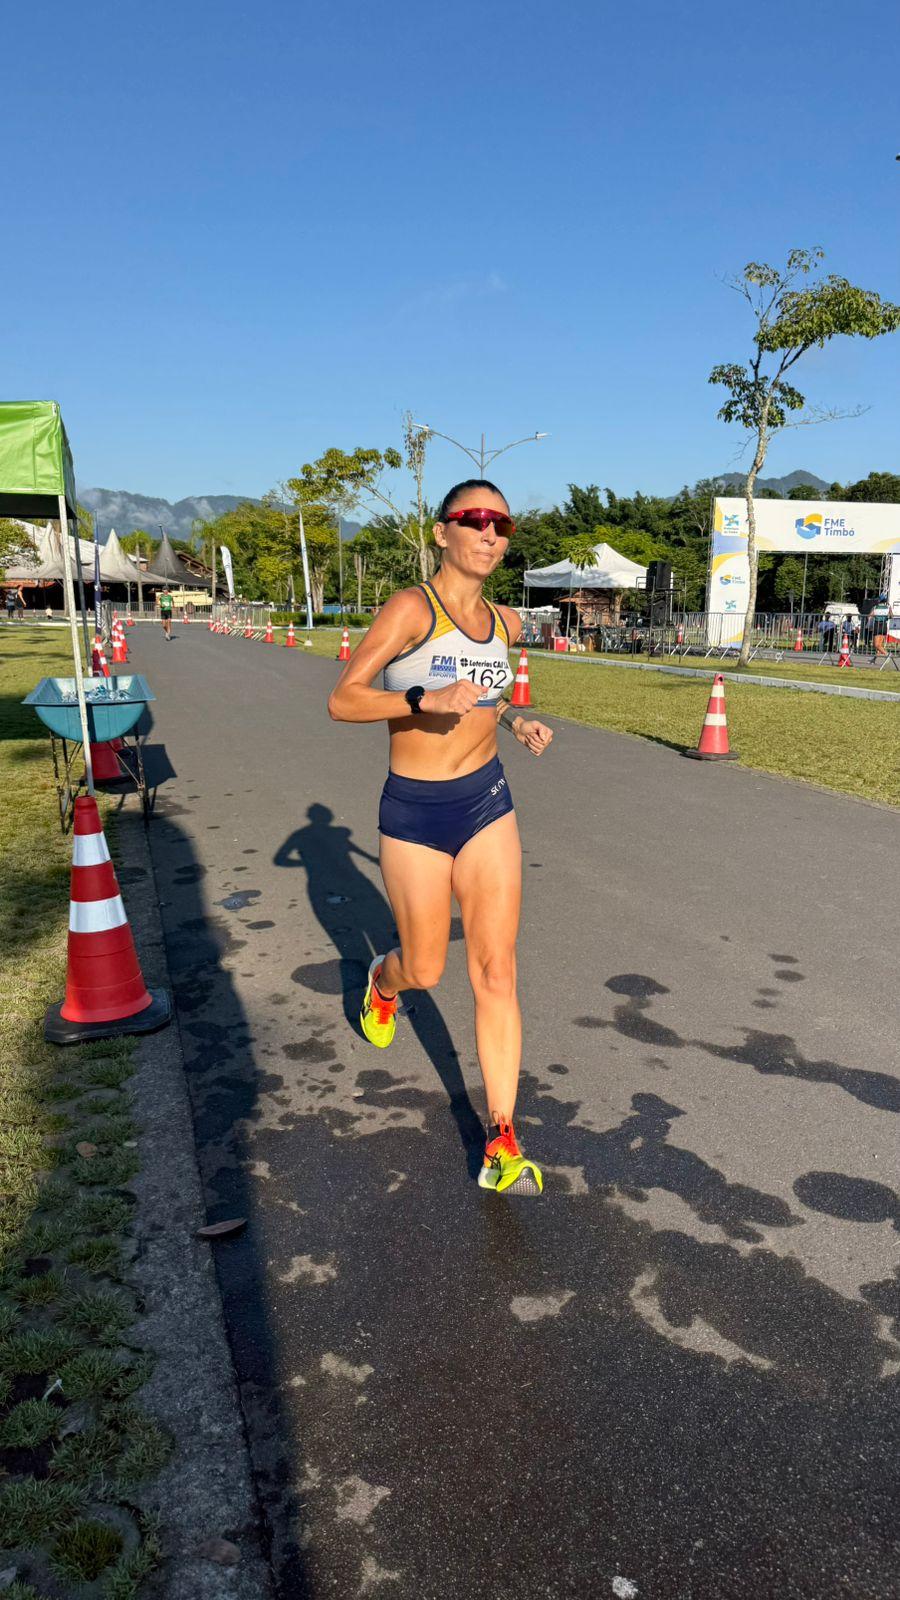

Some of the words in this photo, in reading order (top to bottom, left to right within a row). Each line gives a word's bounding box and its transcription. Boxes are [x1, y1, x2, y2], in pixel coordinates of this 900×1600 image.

[824, 518, 846, 527] FME
[824, 527, 855, 537] Timbó
[469, 660, 493, 668] Loterias
[467, 668, 507, 689] 162
